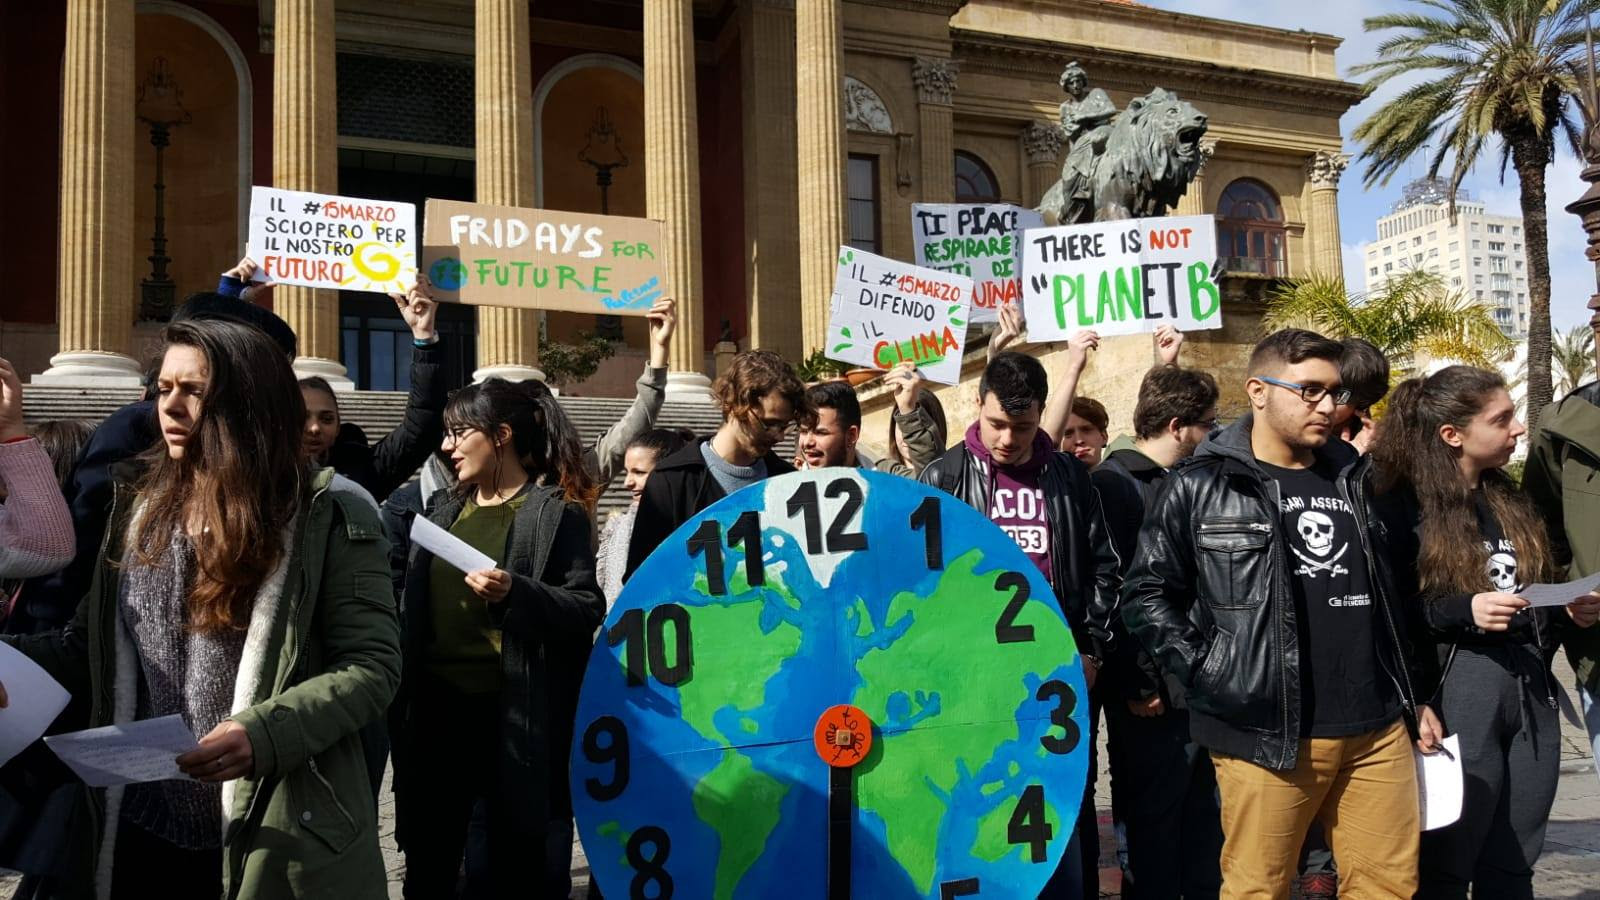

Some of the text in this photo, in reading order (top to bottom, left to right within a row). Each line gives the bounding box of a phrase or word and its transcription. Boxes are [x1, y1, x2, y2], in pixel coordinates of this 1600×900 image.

[269, 197, 396, 222] IL #15MARZO
[916, 207, 1018, 236] TI PIACE
[265, 217, 406, 243] SCIOPERO PER
[265, 236, 354, 256] IL NOSTRO
[450, 214, 655, 260] FRIDAYS FOR
[1033, 228, 1192, 263] THERE IS NOT
[264, 255, 343, 283] FUTURO
[473, 258, 612, 294] FUTURE
[851, 263, 960, 302] IL #15MARZO
[991, 258, 1014, 278] DI
[859, 288, 935, 321] DIFENDO
[971, 278, 1024, 309] UINAR
[862, 320, 884, 339] IL
[873, 325, 959, 369] CLIMA
[786, 477, 868, 555] 12
[1311, 497, 1353, 515] ASSETA
[909, 496, 944, 570] 1
[687, 510, 765, 596] 11
[994, 571, 1036, 643] 2
[606, 603, 694, 687] 10
[1036, 679, 1081, 755] 3
[581, 715, 630, 801] 9
[1007, 785, 1053, 863] 4
[627, 826, 675, 900] 8
